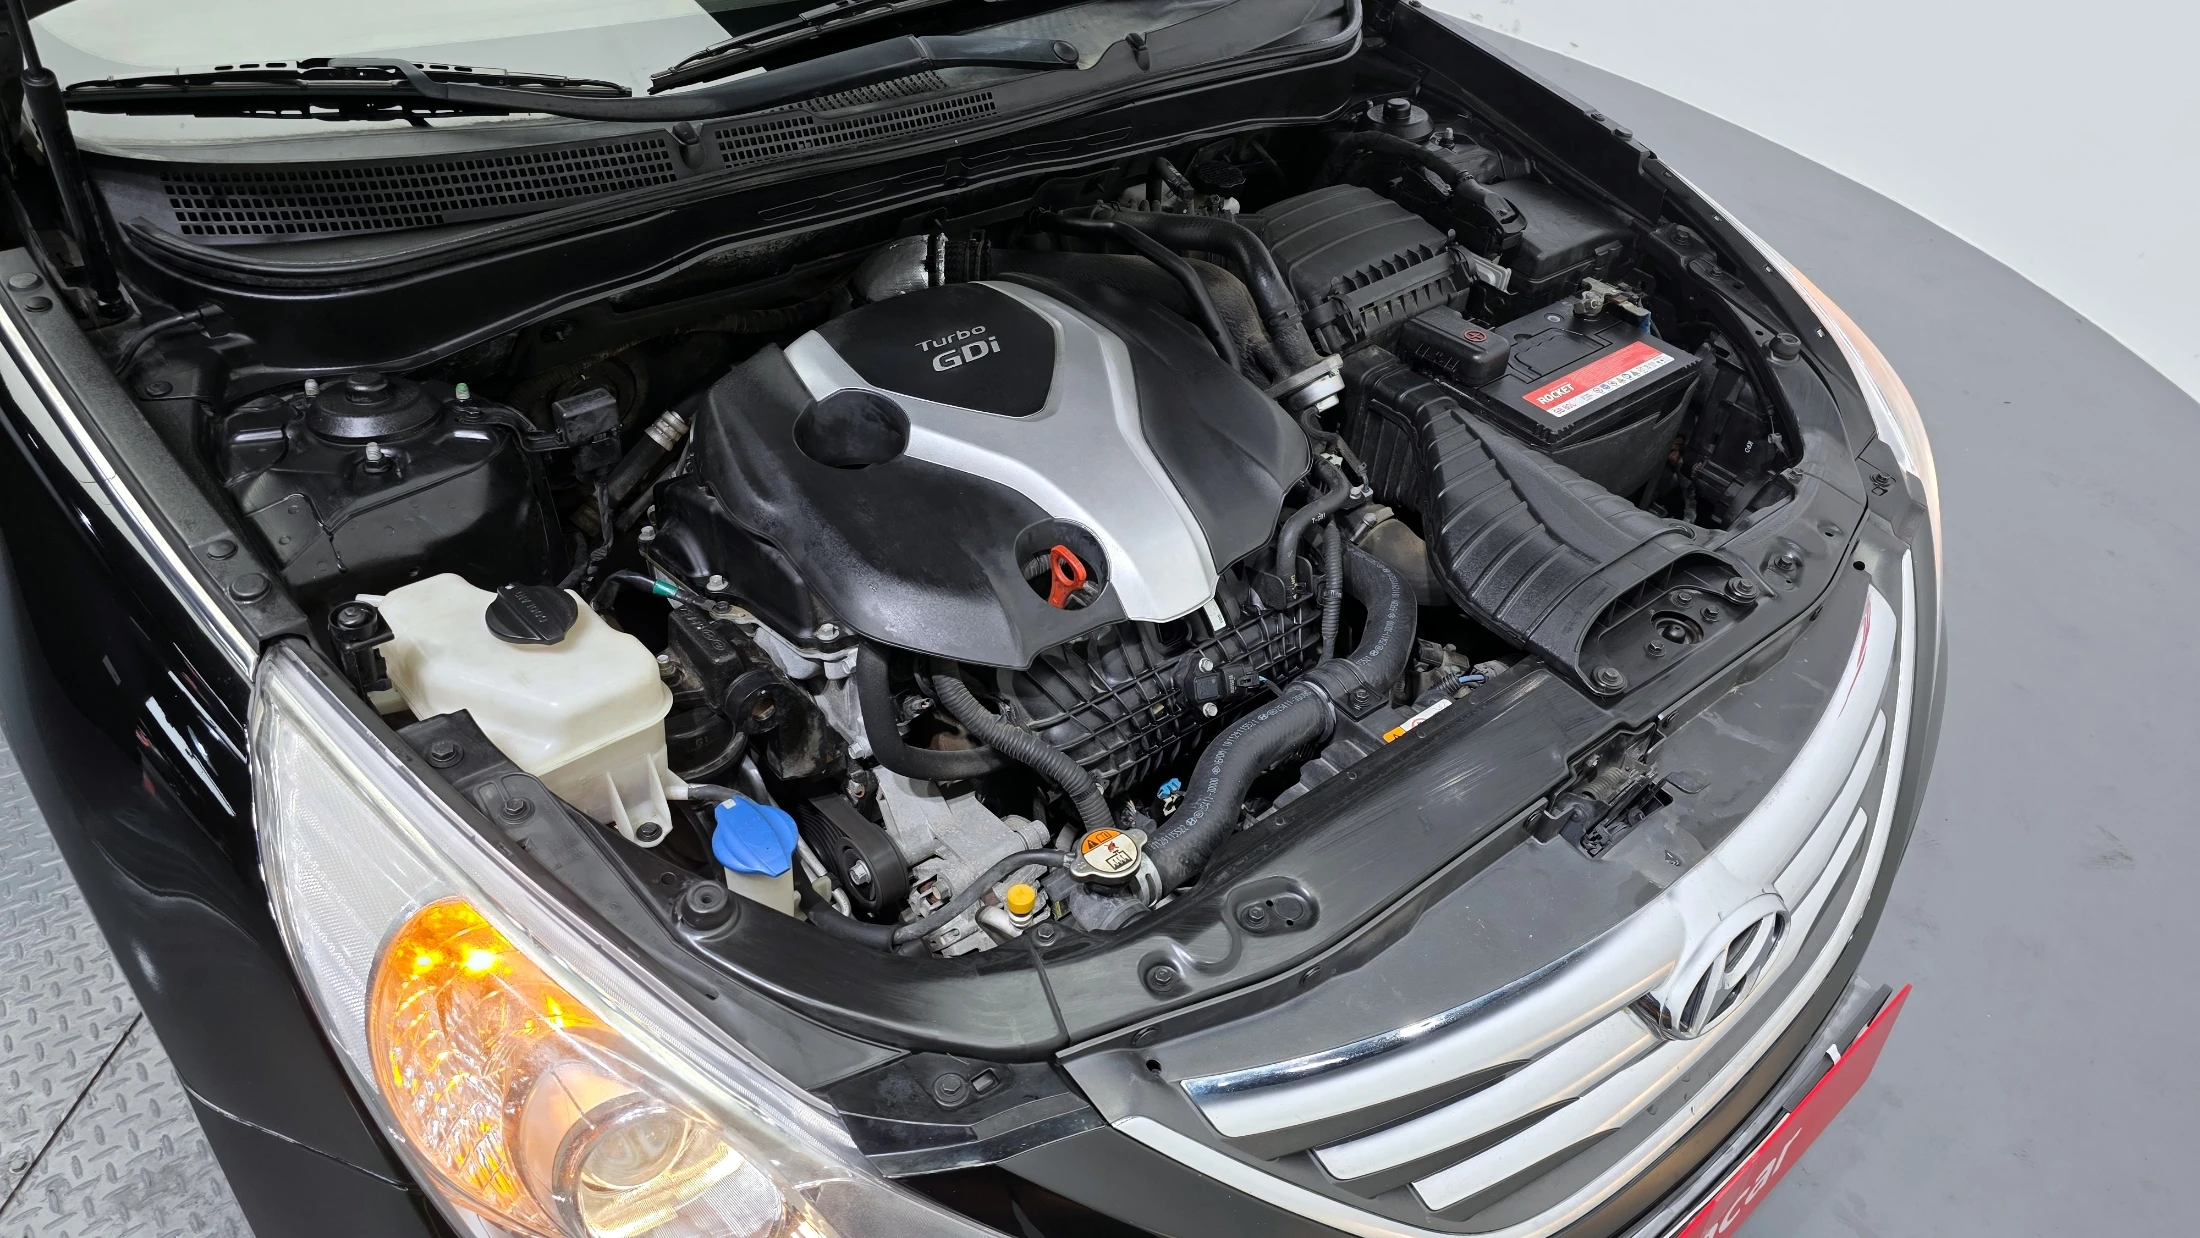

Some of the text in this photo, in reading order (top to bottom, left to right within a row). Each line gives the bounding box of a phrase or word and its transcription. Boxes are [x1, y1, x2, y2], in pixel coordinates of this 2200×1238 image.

[915, 325, 986, 351] Turbo
[932, 335, 1001, 372] GDi
[1536, 382, 1576, 405] ROCKET
